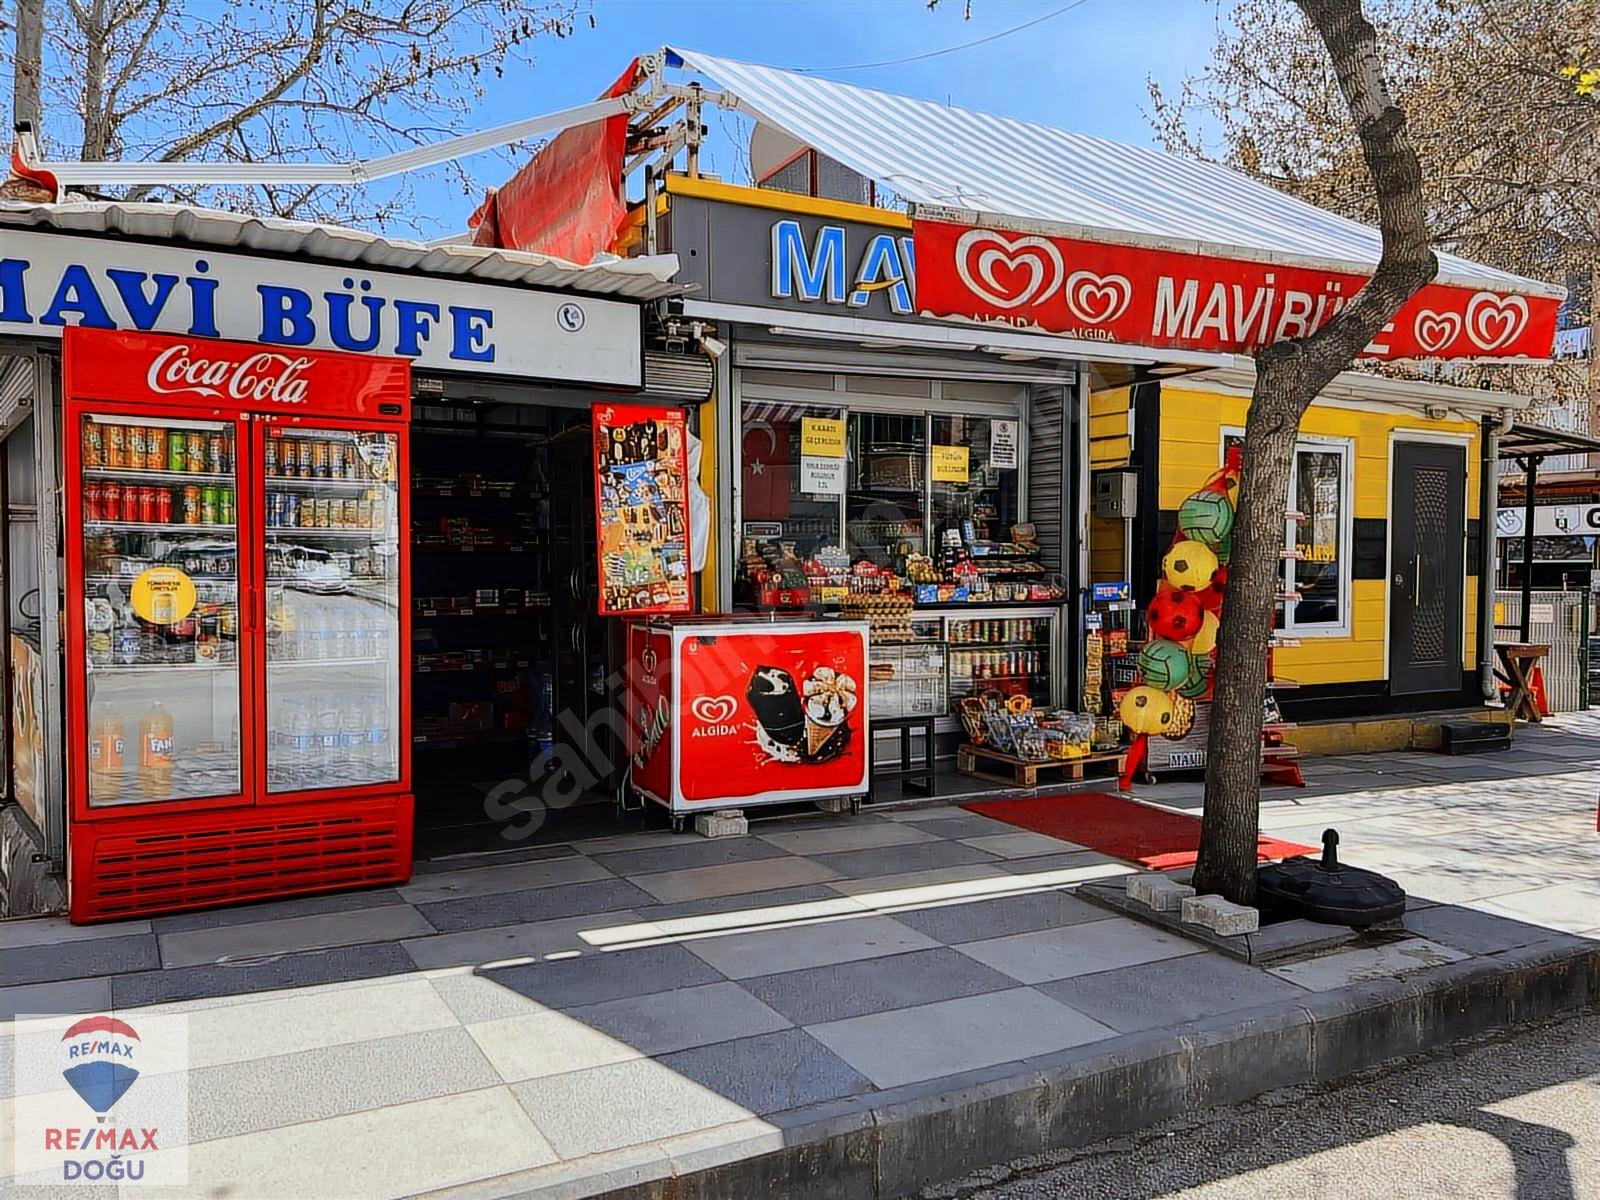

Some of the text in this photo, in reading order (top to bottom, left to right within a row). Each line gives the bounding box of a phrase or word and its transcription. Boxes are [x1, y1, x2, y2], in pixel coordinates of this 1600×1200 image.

[257, 277, 495, 363] BÜFE
[147, 344, 318, 404] Coca-Cola
[691, 724, 738, 738] ALGIDA
